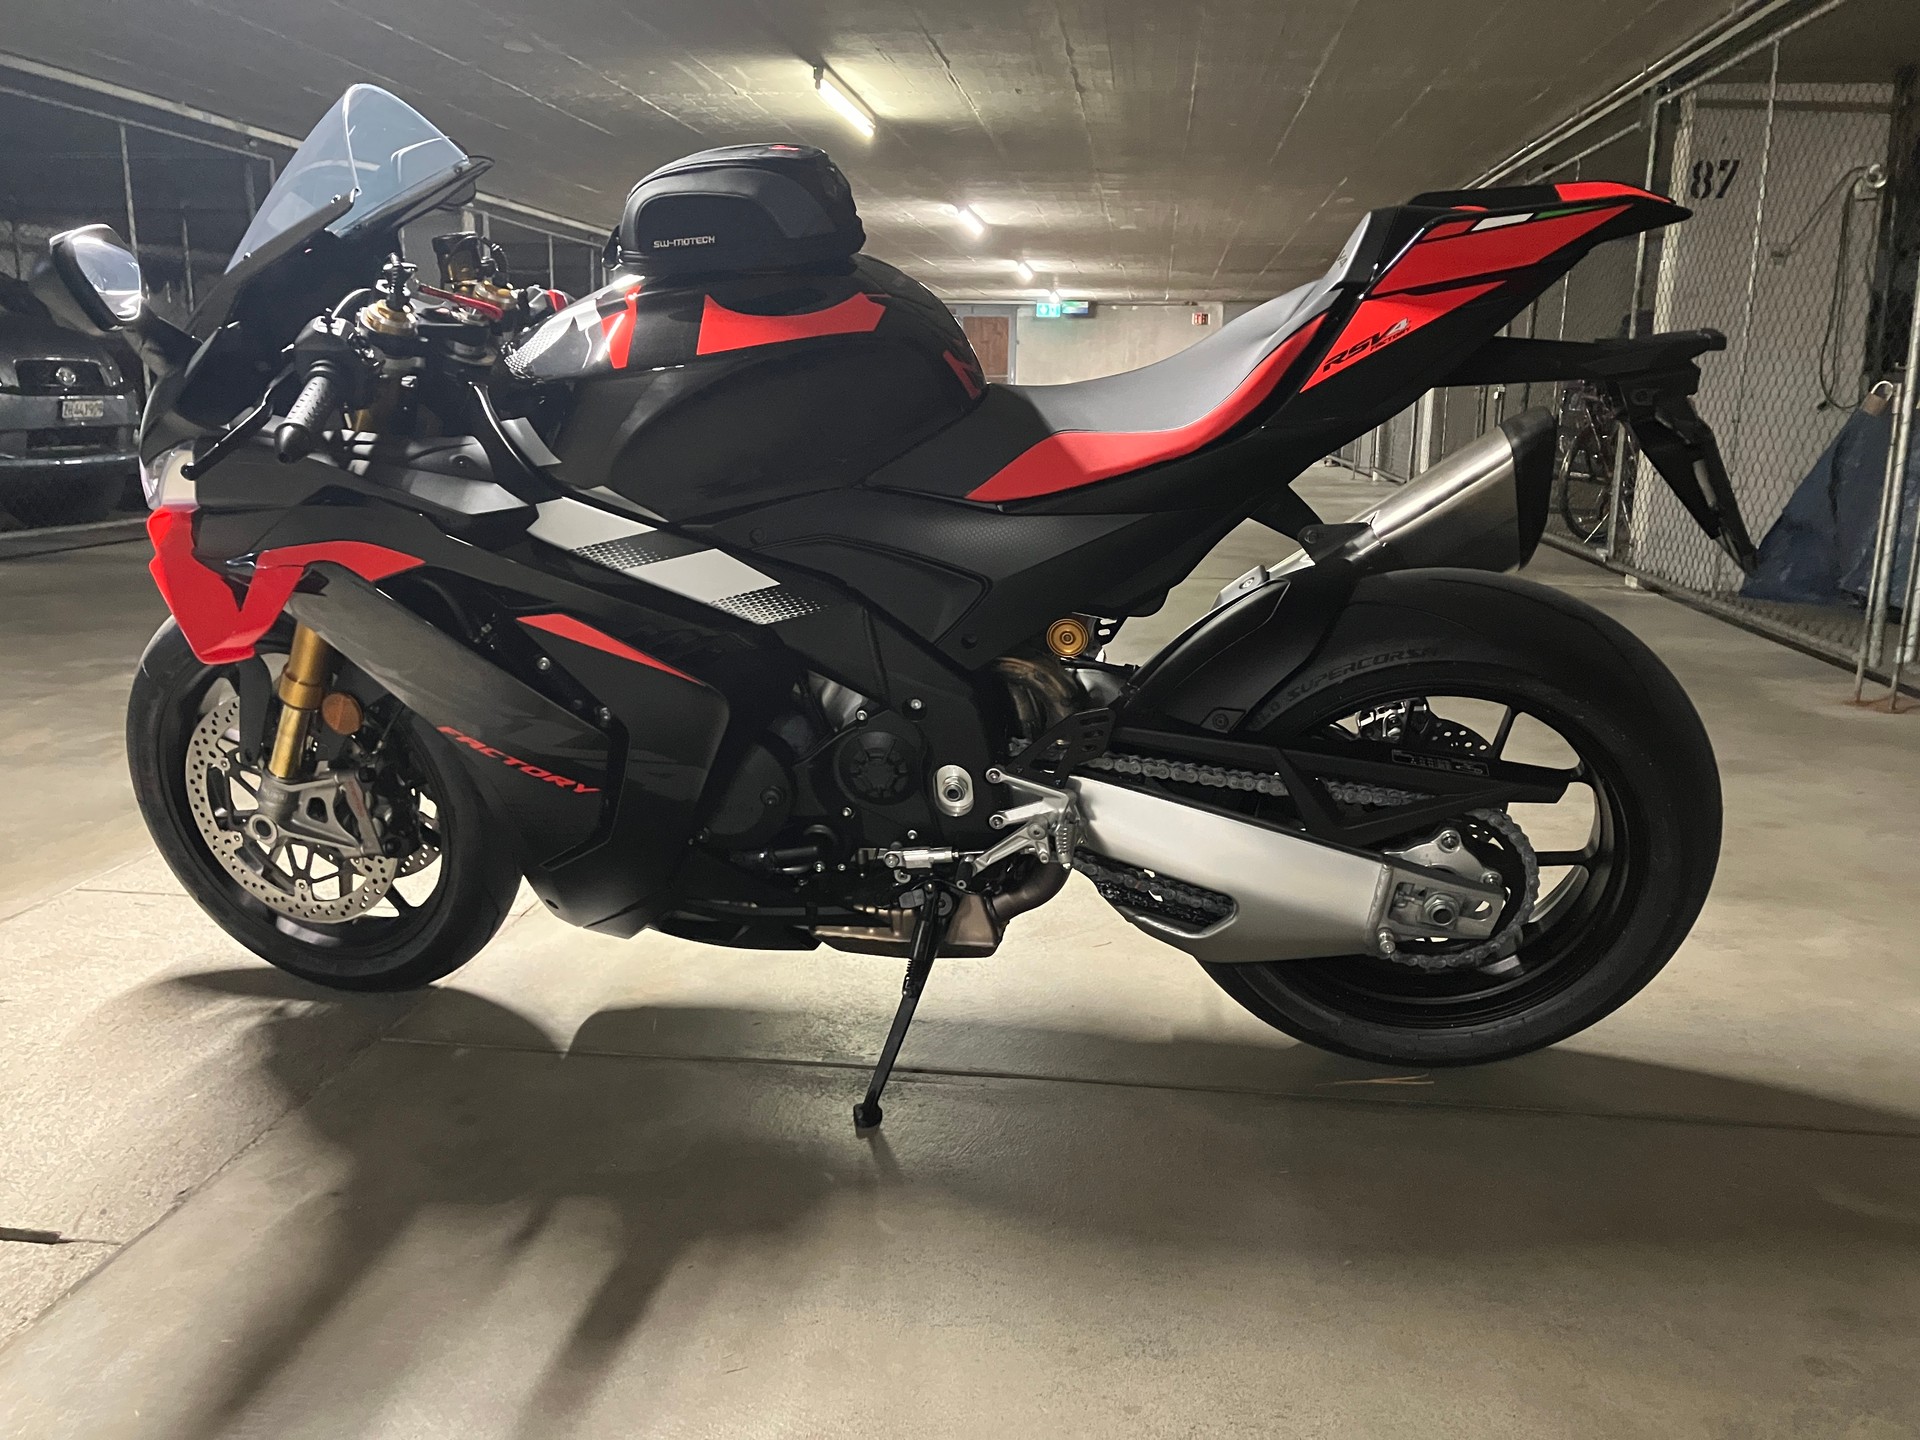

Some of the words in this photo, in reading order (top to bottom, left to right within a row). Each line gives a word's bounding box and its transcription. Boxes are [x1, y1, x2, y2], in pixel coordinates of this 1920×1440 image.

[1691, 159, 1740, 199] 87
[653, 235, 716, 249] SW-MOTECH
[1323, 317, 1408, 373] RSV4
[436, 725, 600, 793] FACTORY
